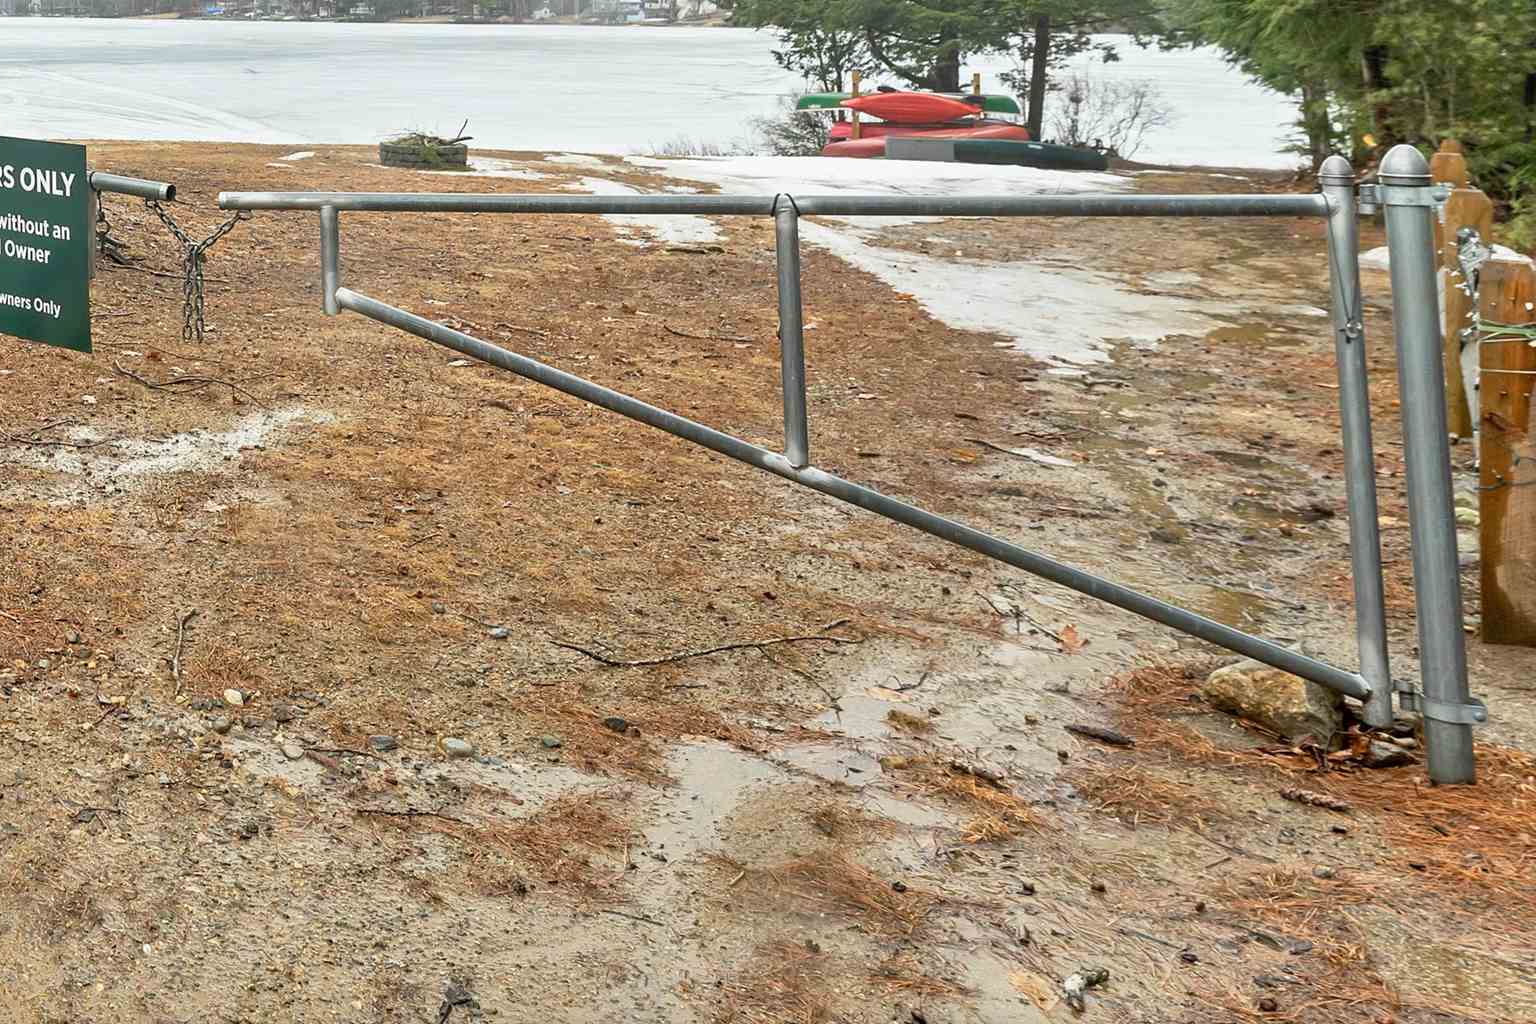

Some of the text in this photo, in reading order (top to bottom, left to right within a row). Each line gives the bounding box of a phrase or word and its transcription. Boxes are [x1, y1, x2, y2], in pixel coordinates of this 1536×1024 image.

[20, 167, 75, 197] ONLY
[52, 224, 70, 241] an
[5, 240, 50, 264] Owner
[34, 297, 61, 319] Only
